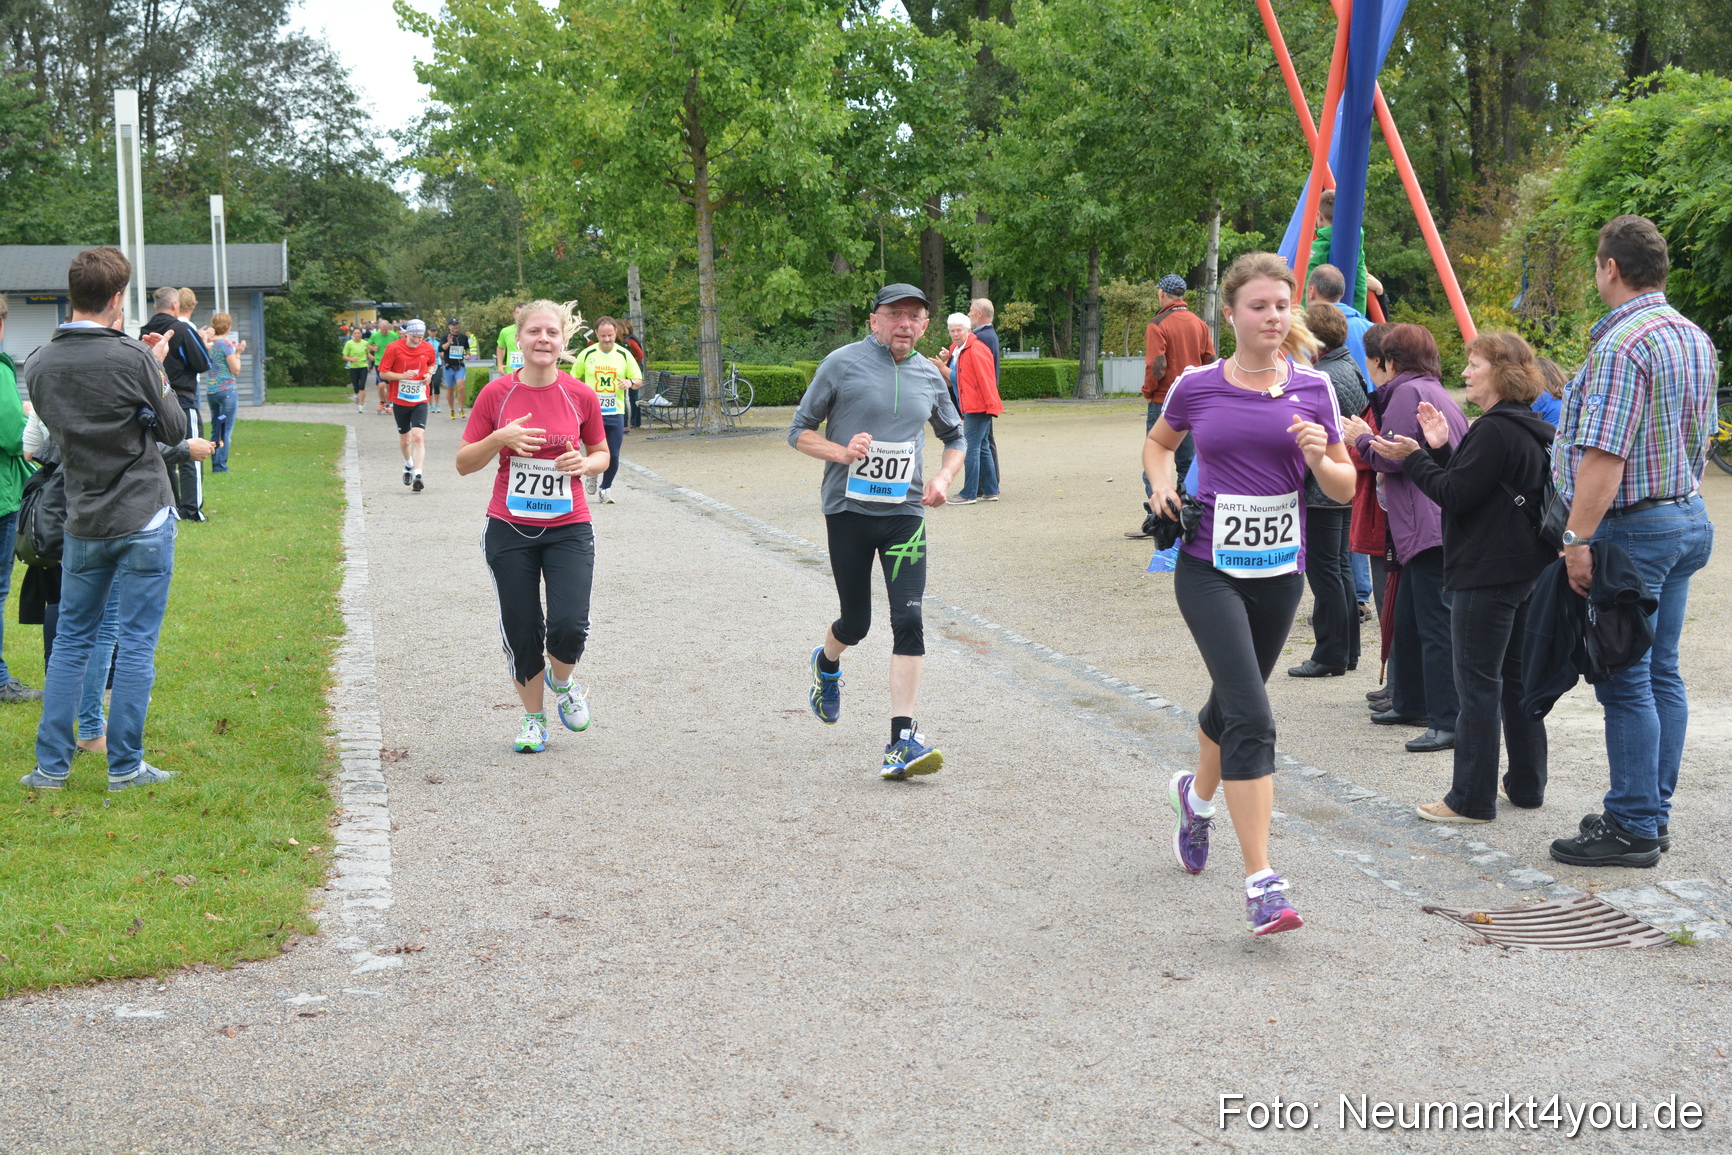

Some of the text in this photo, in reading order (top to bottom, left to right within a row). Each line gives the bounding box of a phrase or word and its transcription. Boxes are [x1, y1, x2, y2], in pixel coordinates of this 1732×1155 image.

[401, 384, 420, 394] 2358
[600, 398, 615, 408] 738
[512, 462, 557, 472] PARTL Neuma
[855, 455, 911, 480] 2307
[514, 472, 564, 496] 2791
[869, 484, 892, 495] Hans
[526, 501, 552, 511] Katrin
[1217, 502, 1288, 513] PARTL Neumarkt
[1223, 513, 1293, 547] 2552
